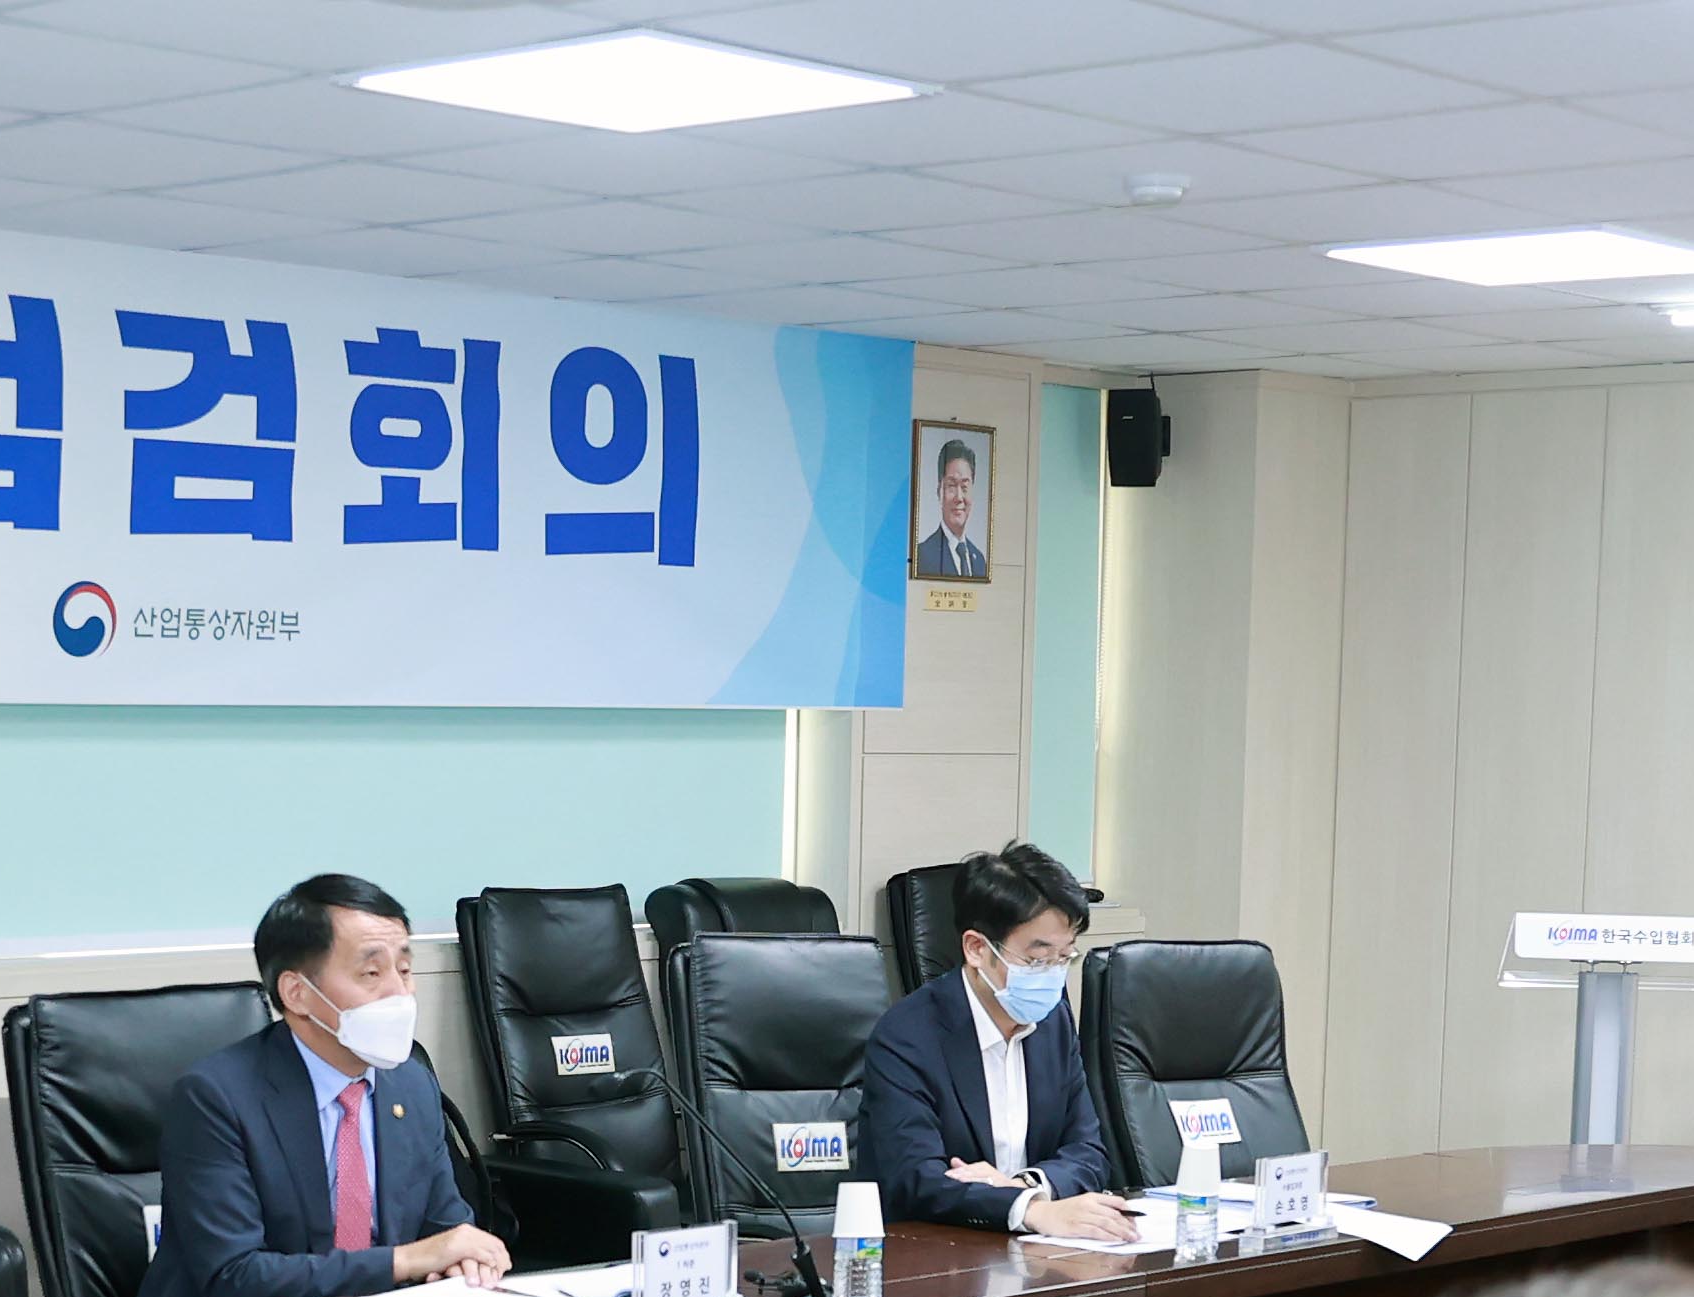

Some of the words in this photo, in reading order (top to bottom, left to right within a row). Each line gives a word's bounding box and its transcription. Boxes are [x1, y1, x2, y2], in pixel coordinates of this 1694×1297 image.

[133, 607, 301, 641] 산업통상자원부
[1548, 927, 1598, 942] KOIMA
[1602, 928, 1694, 946] 한국수입협회
[559, 1045, 610, 1065] KOIMA
[1180, 1112, 1232, 1132] KOIMA
[780, 1136, 842, 1159] KOIMA
